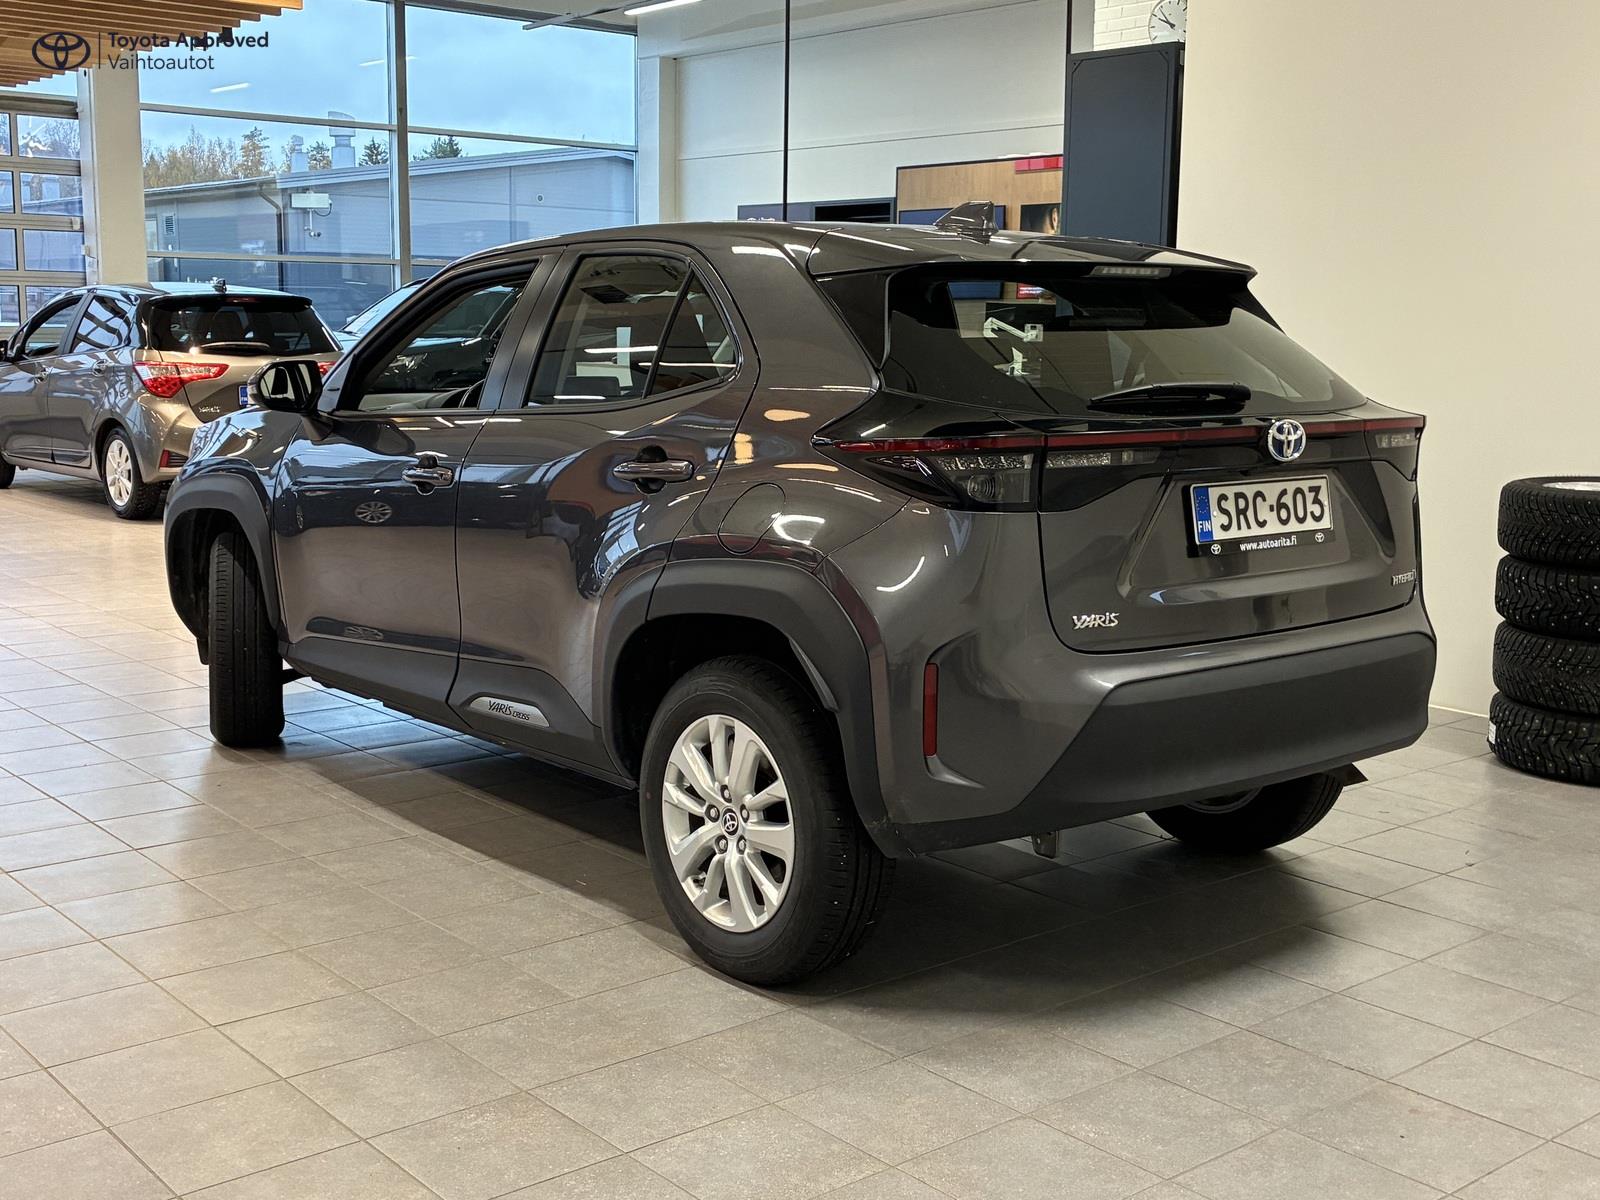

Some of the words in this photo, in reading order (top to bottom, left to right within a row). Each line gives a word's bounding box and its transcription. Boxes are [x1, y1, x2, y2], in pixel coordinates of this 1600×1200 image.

[1216, 485, 1325, 532] SRC-603
[1198, 520, 1212, 533] FIN
[1239, 535, 1298, 552] www.autoarita.fi
[1072, 611, 1120, 630] YARIS
[487, 699, 514, 716] YARIS
